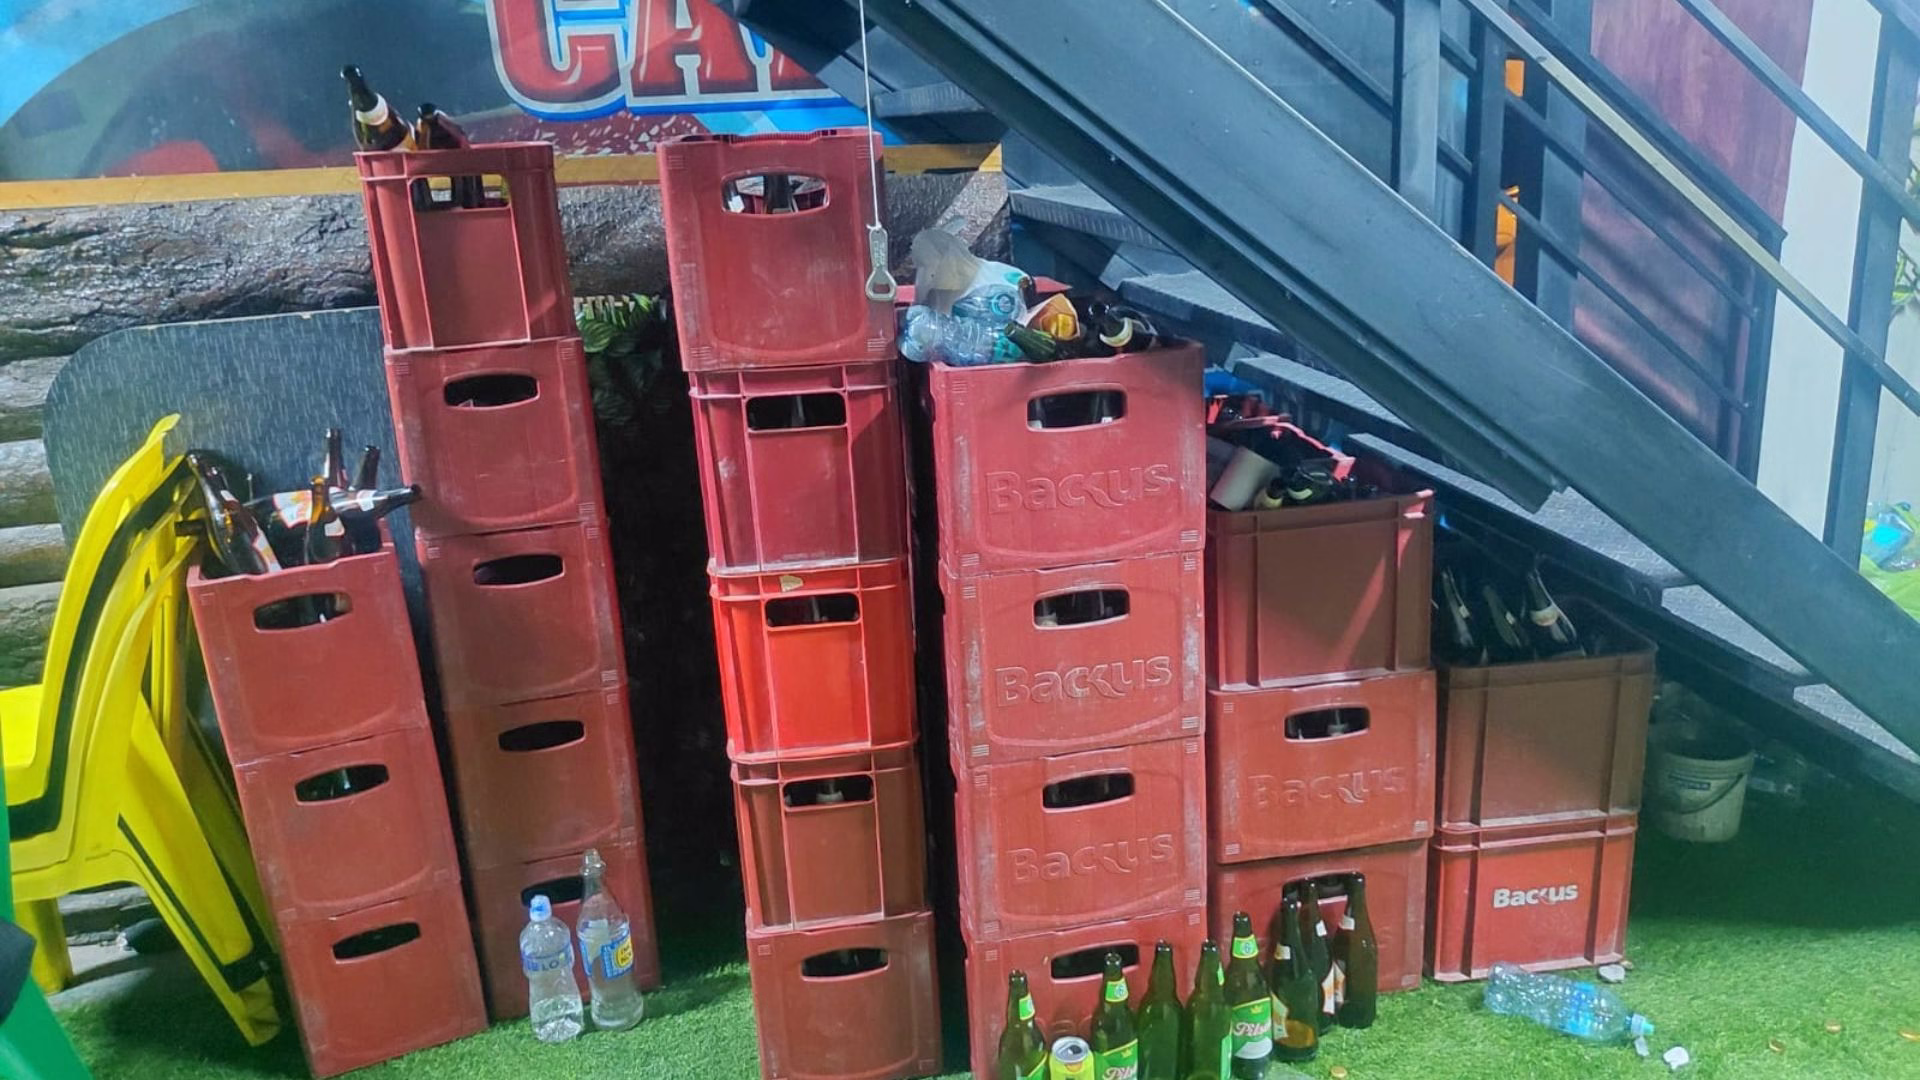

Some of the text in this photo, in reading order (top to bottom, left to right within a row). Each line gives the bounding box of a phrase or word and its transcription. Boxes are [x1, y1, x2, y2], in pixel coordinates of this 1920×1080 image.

[985, 464, 1174, 515] Backus
[995, 656, 1173, 706] Backus
[1007, 833, 1176, 884] Backus
[1493, 884, 1578, 908] Backus
